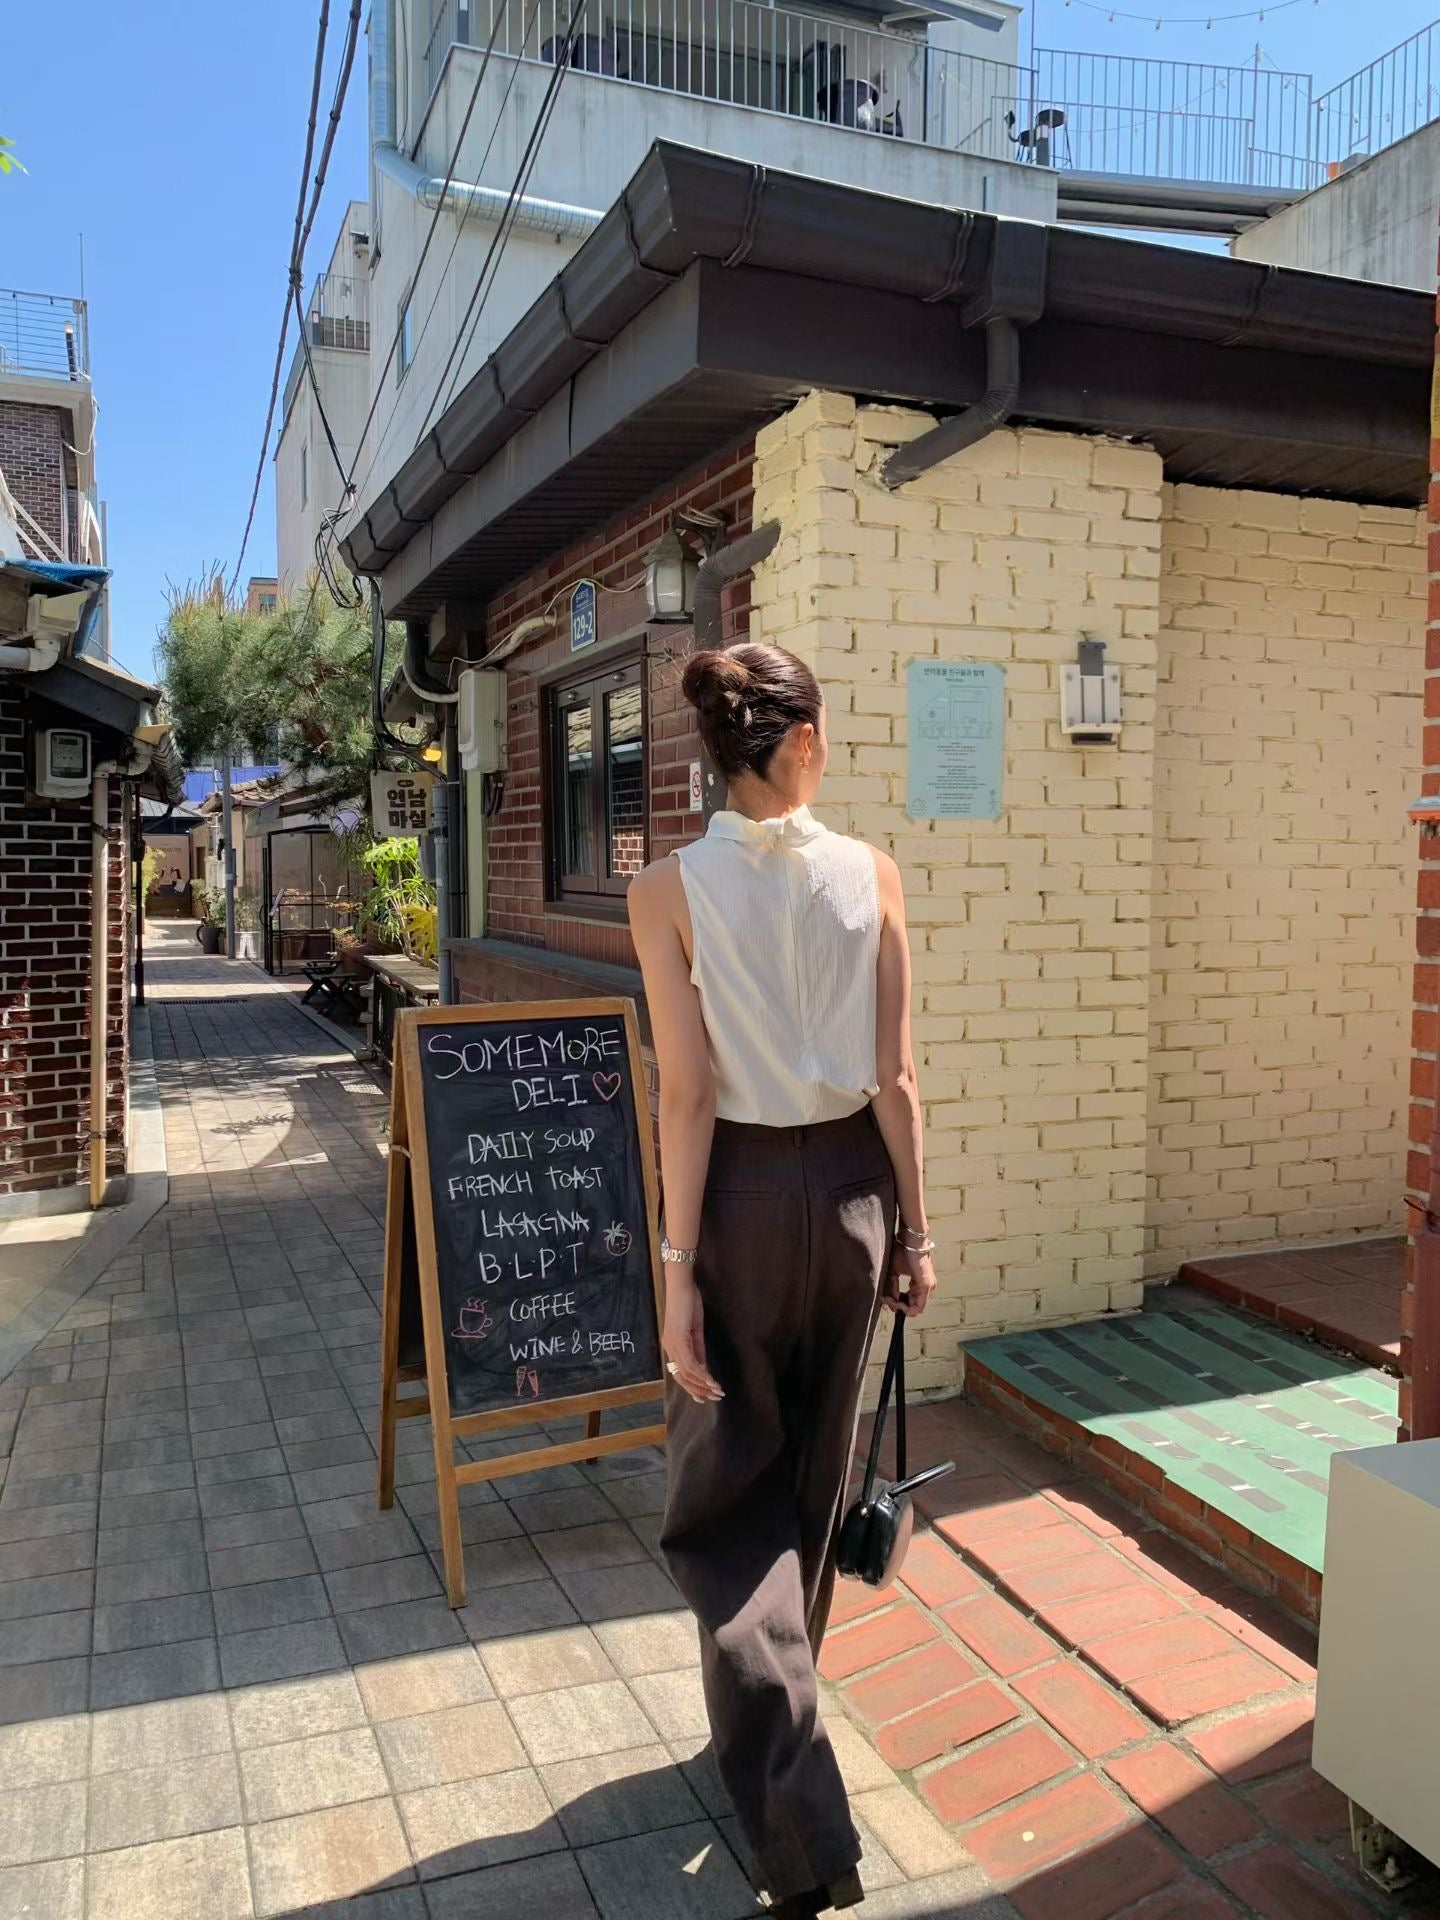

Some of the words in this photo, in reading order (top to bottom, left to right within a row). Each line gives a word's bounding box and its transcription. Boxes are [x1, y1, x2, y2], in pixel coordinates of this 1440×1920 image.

[573, 611, 593, 641] 129-2
[387, 788, 427, 808] 연남
[388, 809, 427, 829] 마실
[428, 1027, 621, 1080] SOMEMORE
[511, 1074, 588, 1112] DELI
[467, 1131, 535, 1165] DAILY
[447, 1170, 534, 1201] FRENCH
[545, 1165, 604, 1191] TOAST
[480, 1209, 590, 1239] LASAGNA
[509, 1291, 577, 1322] COFFEE
[509, 1336, 566, 1362] WINE
[571, 1329, 584, 1354] &
[588, 1330, 635, 1356] BEER
